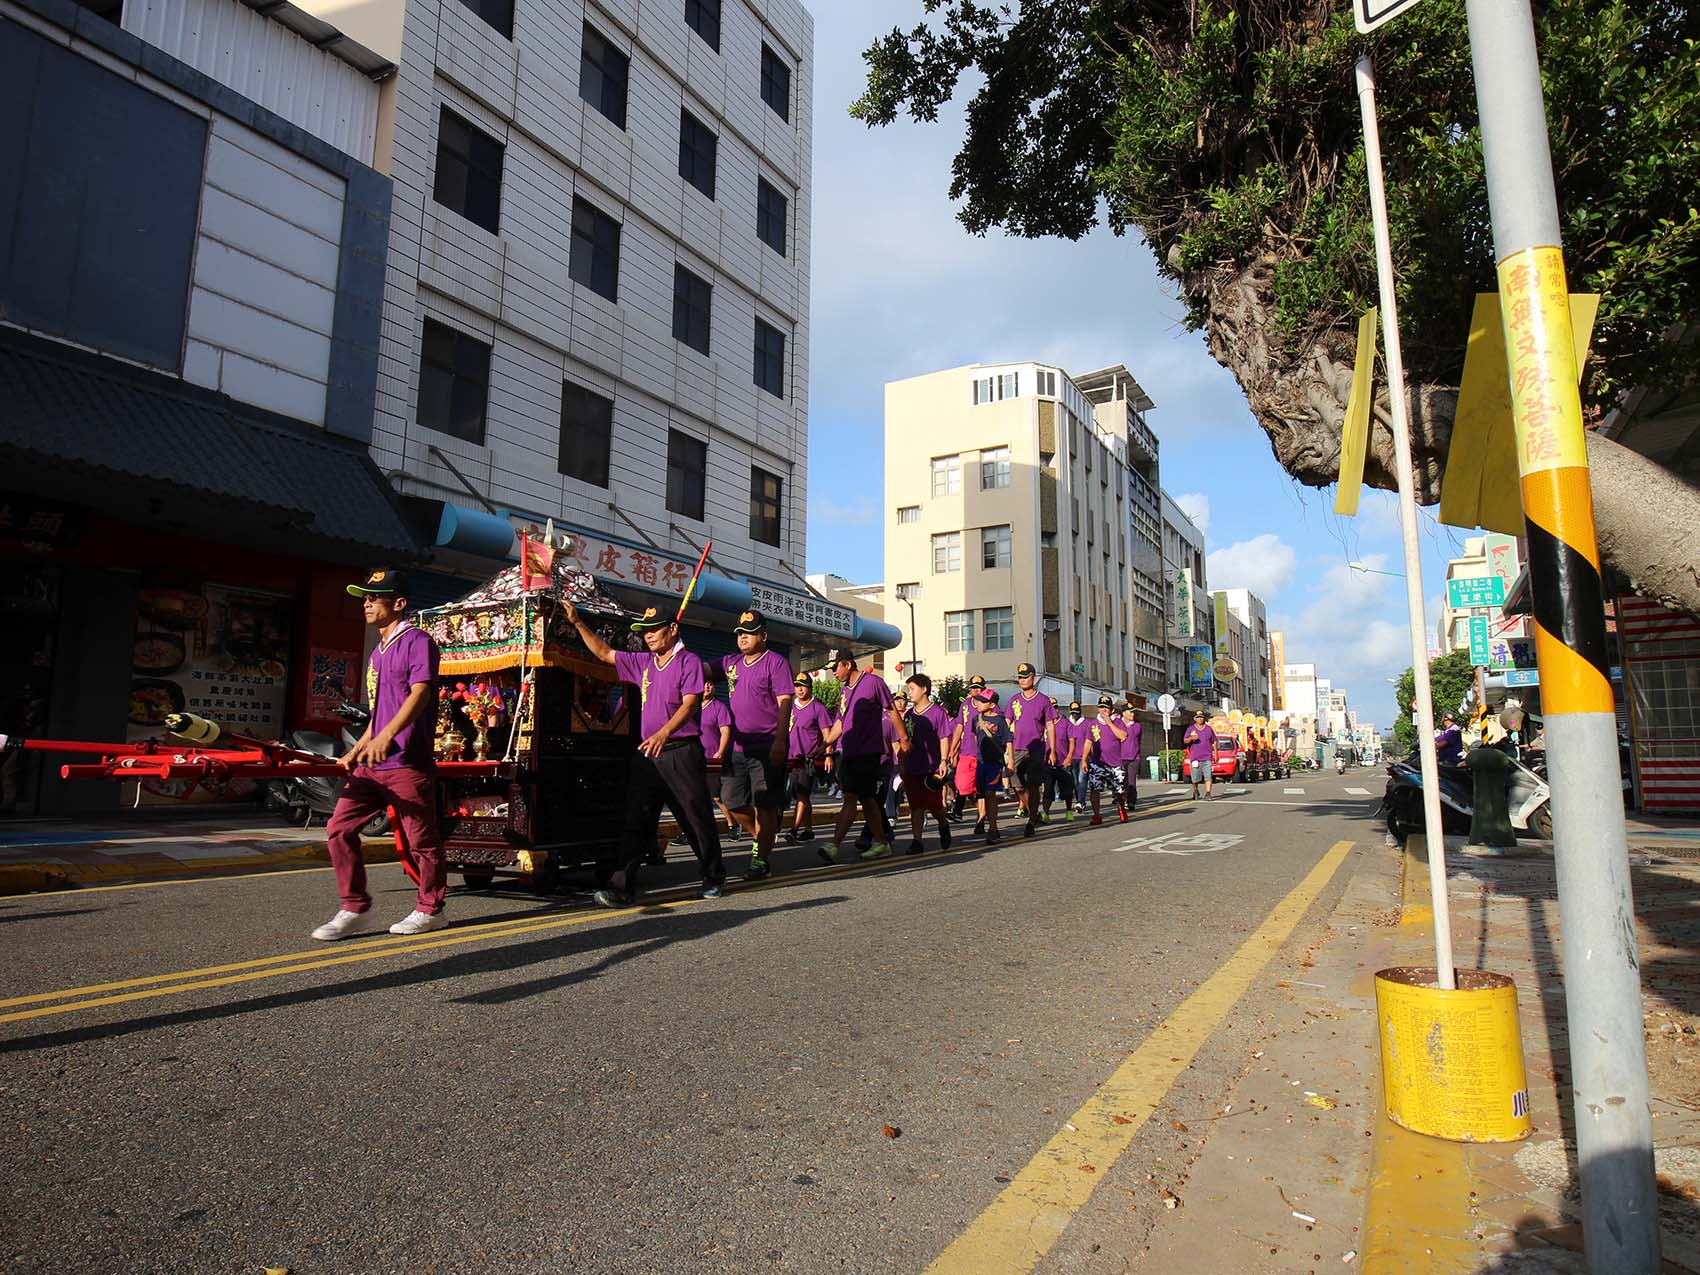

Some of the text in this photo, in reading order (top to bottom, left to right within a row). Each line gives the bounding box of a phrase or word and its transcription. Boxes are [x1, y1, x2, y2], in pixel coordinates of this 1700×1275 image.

[1505, 264, 1561, 464] 南無文殊菩薩
[515, 523, 689, 593] 皮箱行
[1492, 643, 1536, 667] 清粥
